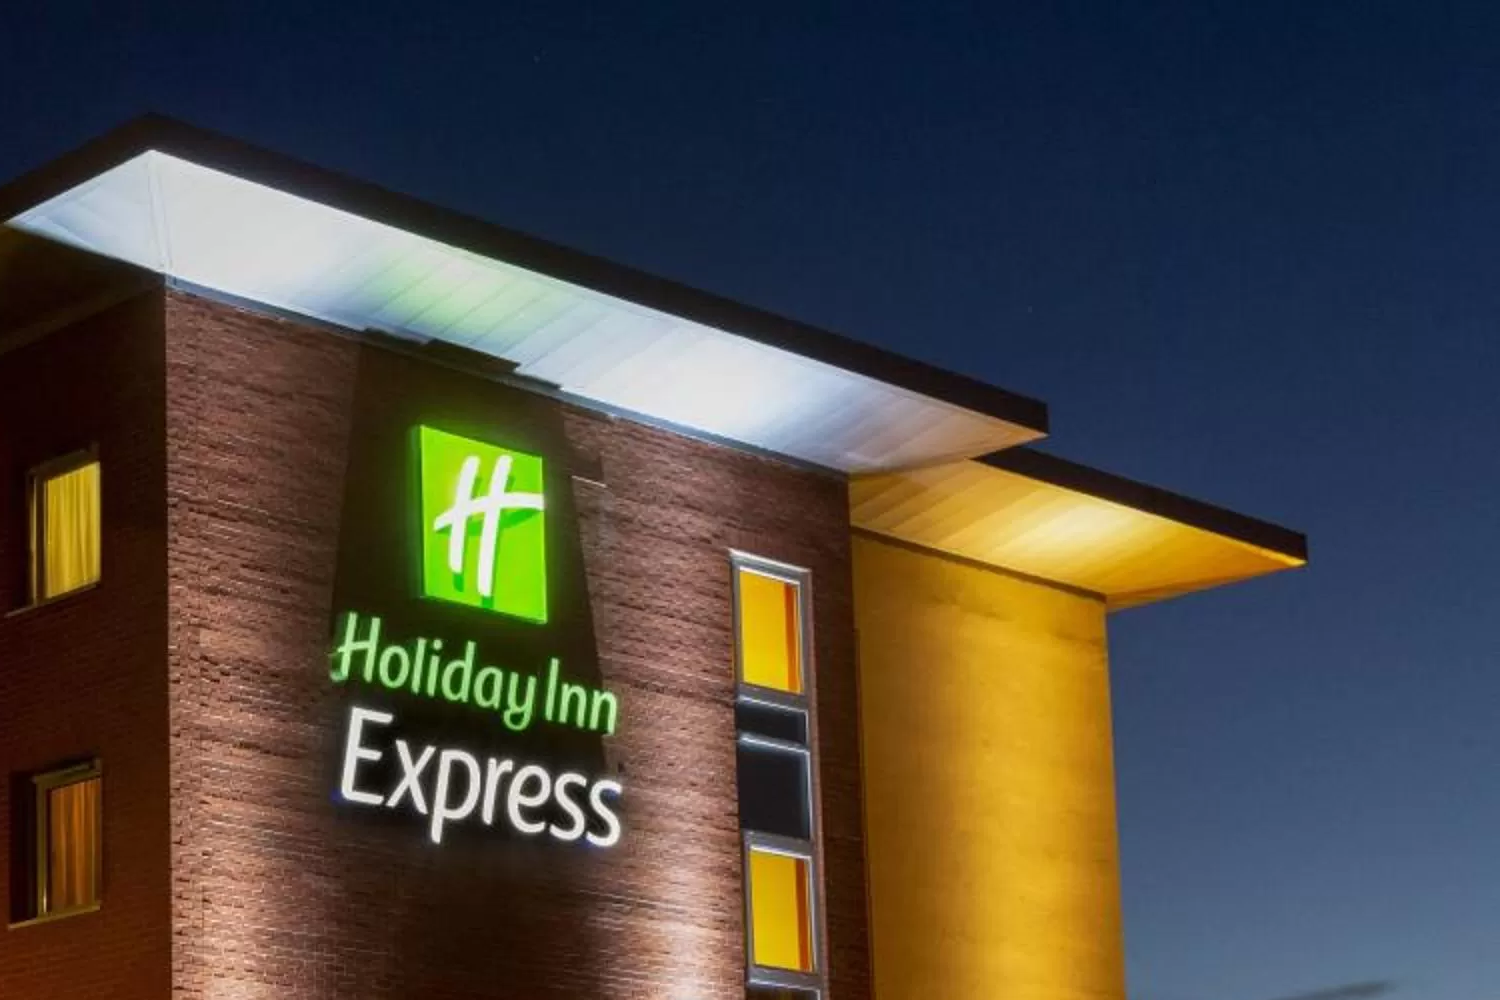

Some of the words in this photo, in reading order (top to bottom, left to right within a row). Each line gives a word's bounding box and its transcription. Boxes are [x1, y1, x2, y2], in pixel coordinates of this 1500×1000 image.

[331, 611, 538, 731] Holiday
[545, 657, 618, 735] Inn
[340, 705, 623, 848] Express
